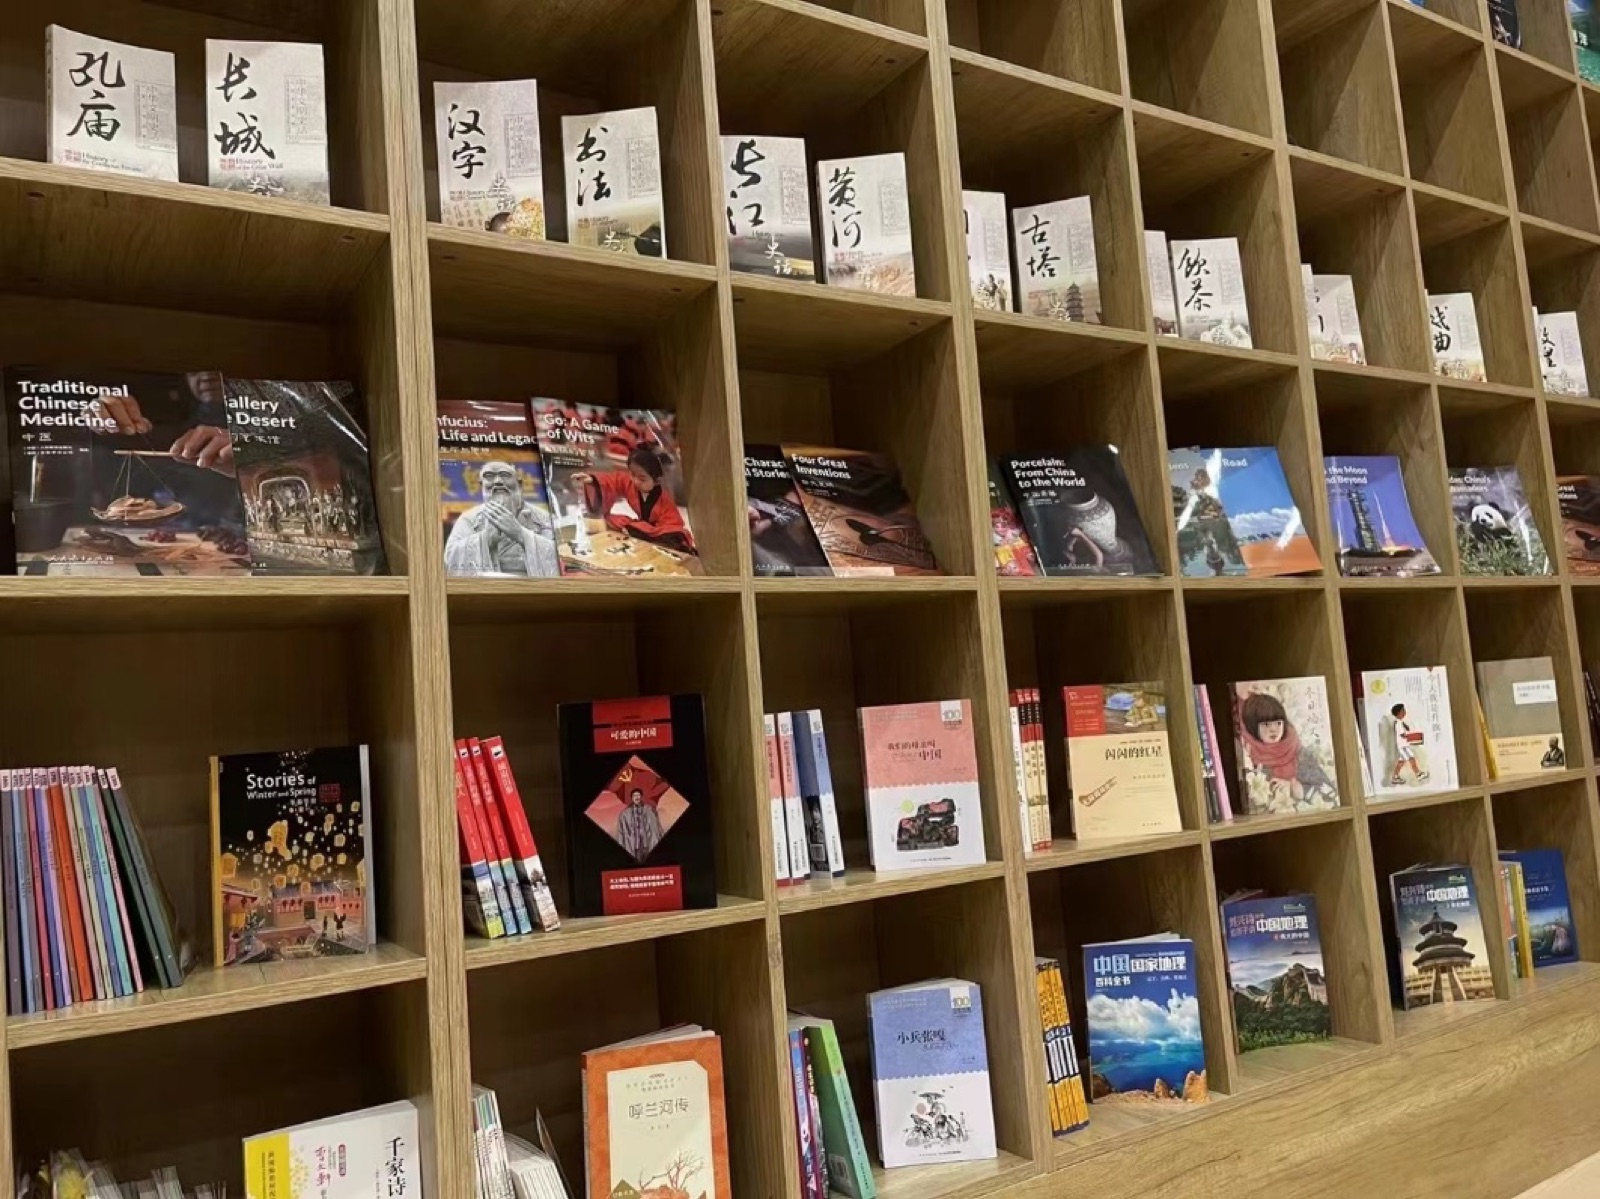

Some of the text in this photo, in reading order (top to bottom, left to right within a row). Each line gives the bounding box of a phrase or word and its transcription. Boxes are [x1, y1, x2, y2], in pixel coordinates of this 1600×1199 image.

[66, 51, 126, 142] 孔庙
[215, 52, 276, 159] 长城
[447, 103, 487, 179] 汉字
[576, 126, 612, 207] 书法
[727, 139, 765, 236] 长江
[829, 167, 862, 248] 黄河
[1021, 214, 1061, 279] 古塔
[17, 380, 129, 398] Traditional
[19, 396, 101, 411] Chinese
[223, 395, 279, 414] allery
[20, 411, 117, 429] Medicine
[236, 412, 296, 429] Desert
[437, 415, 488, 428] nfucius:
[544, 413, 620, 434] Go: A Game
[441, 429, 538, 446] Life and Legac
[547, 429, 595, 444] of Wits
[744, 457, 787, 468] Charac
[791, 453, 848, 469] Four Great
[1010, 458, 1067, 469] Porcelain:
[1221, 458, 1249, 468] Road
[795, 464, 852, 479] Inventions
[1014, 467, 1076, 478] From China
[1018, 477, 1086, 488] to the World
[610, 727, 657, 740] 可爱的中国
[1105, 745, 1163, 761] 闪闪的红星
[246, 772, 317, 789] Stories of
[246, 790, 278, 800] Winter
[289, 787, 317, 798] Spring
[1256, 914, 1309, 934] 中国地理
[1093, 953, 1187, 976] 中国国家地理
[1095, 975, 1131, 988] 百科全书
[628, 1097, 690, 1120] 呼兰河传
[385, 1136, 406, 1197] 千家诗
